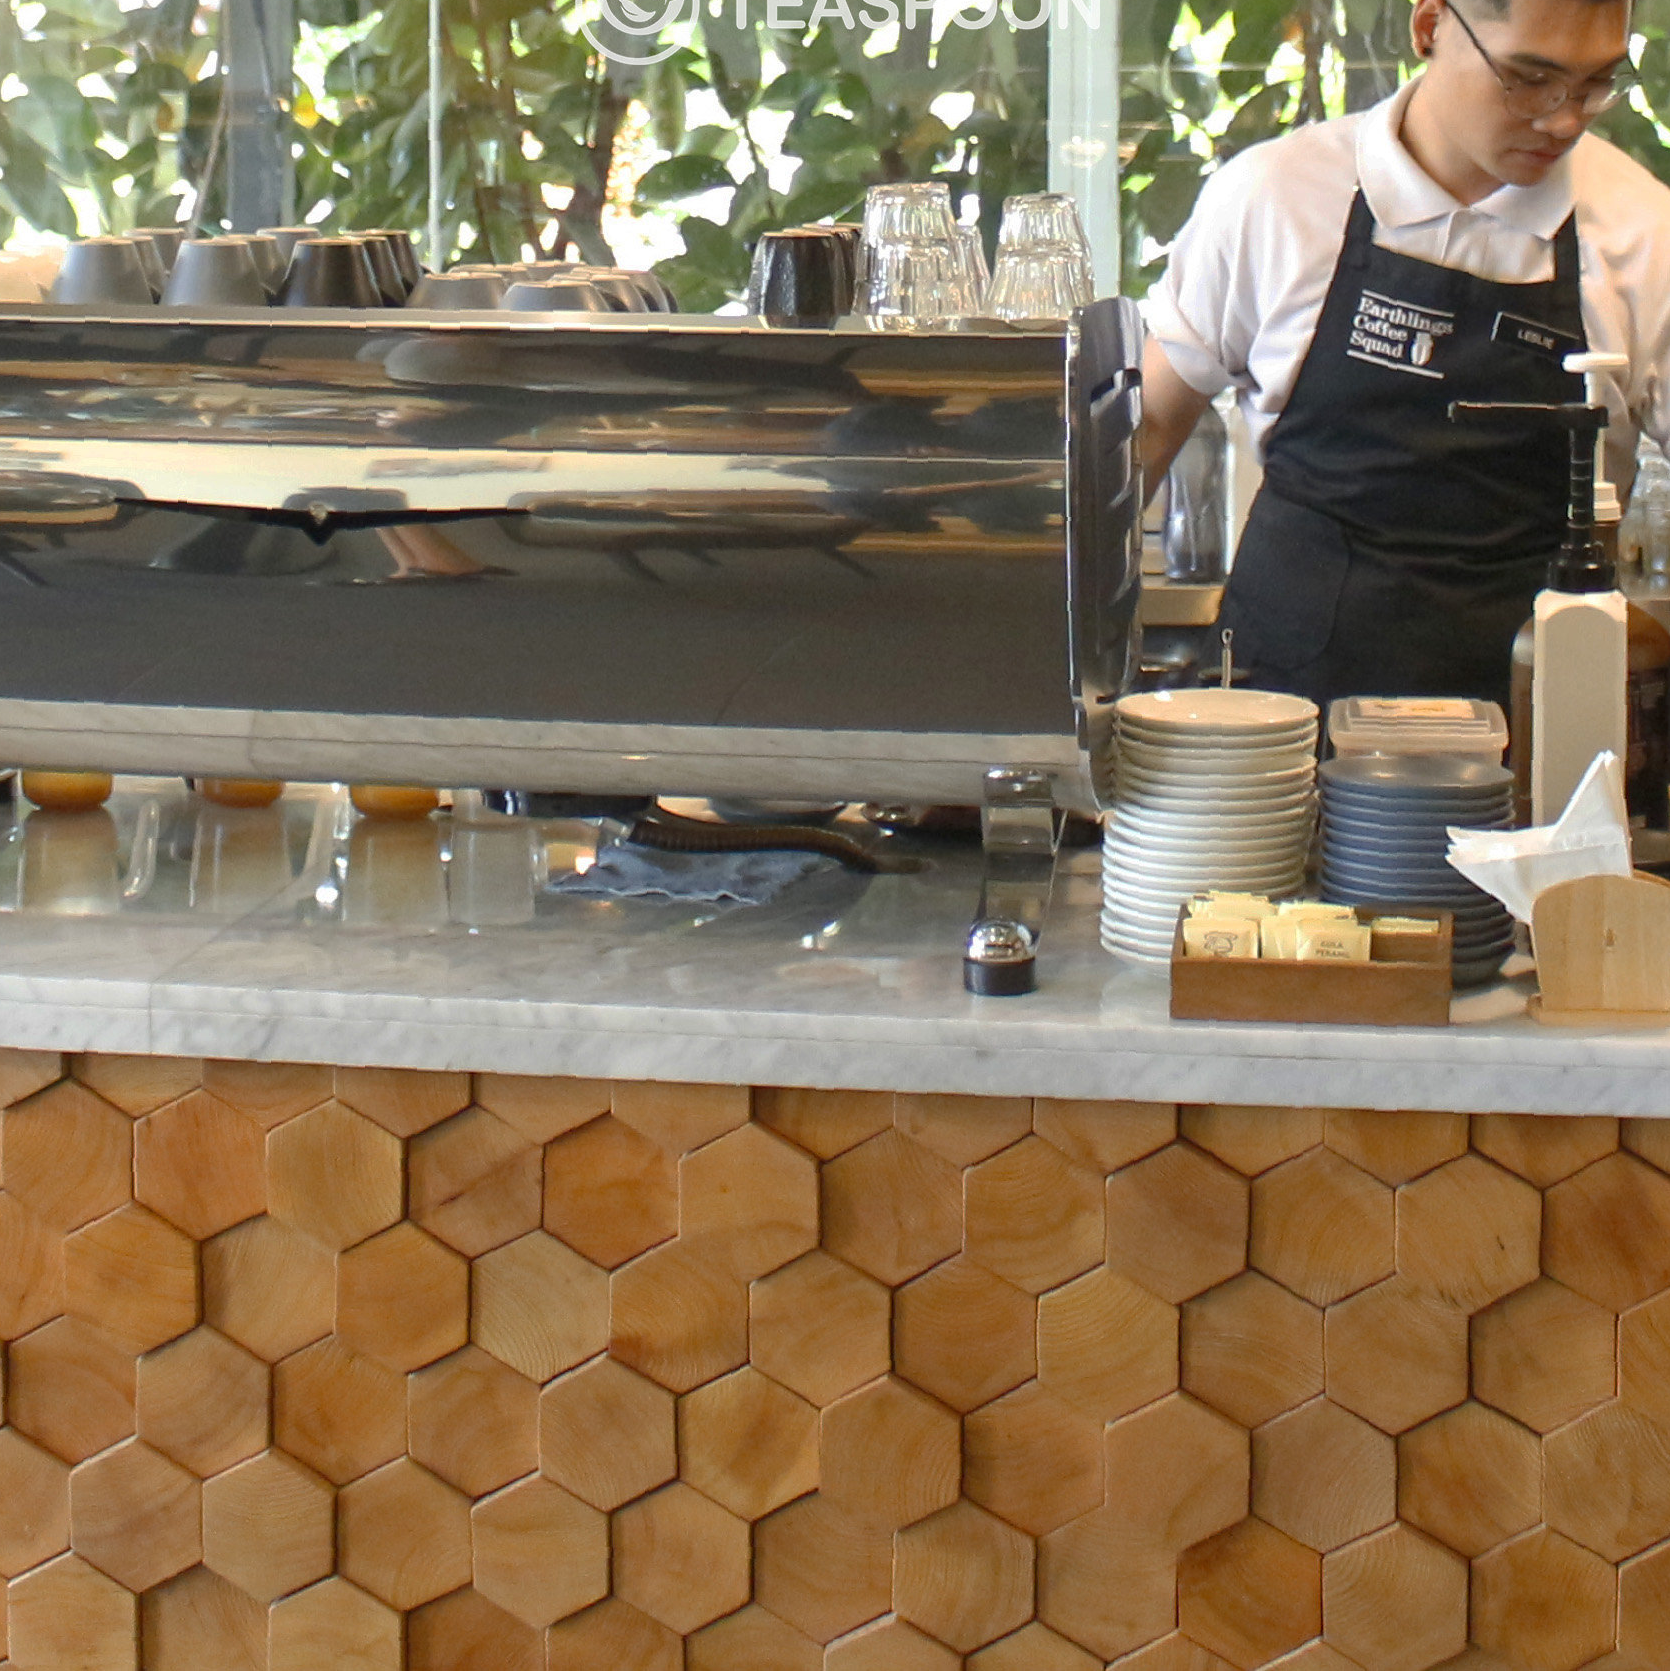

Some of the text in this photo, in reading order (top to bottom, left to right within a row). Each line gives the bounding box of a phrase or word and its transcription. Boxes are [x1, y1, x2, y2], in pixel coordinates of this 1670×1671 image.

[1353, 313, 1409, 343] Coffee
[1358, 295, 1455, 338] Earthlings
[1349, 329, 1405, 360] Squad
